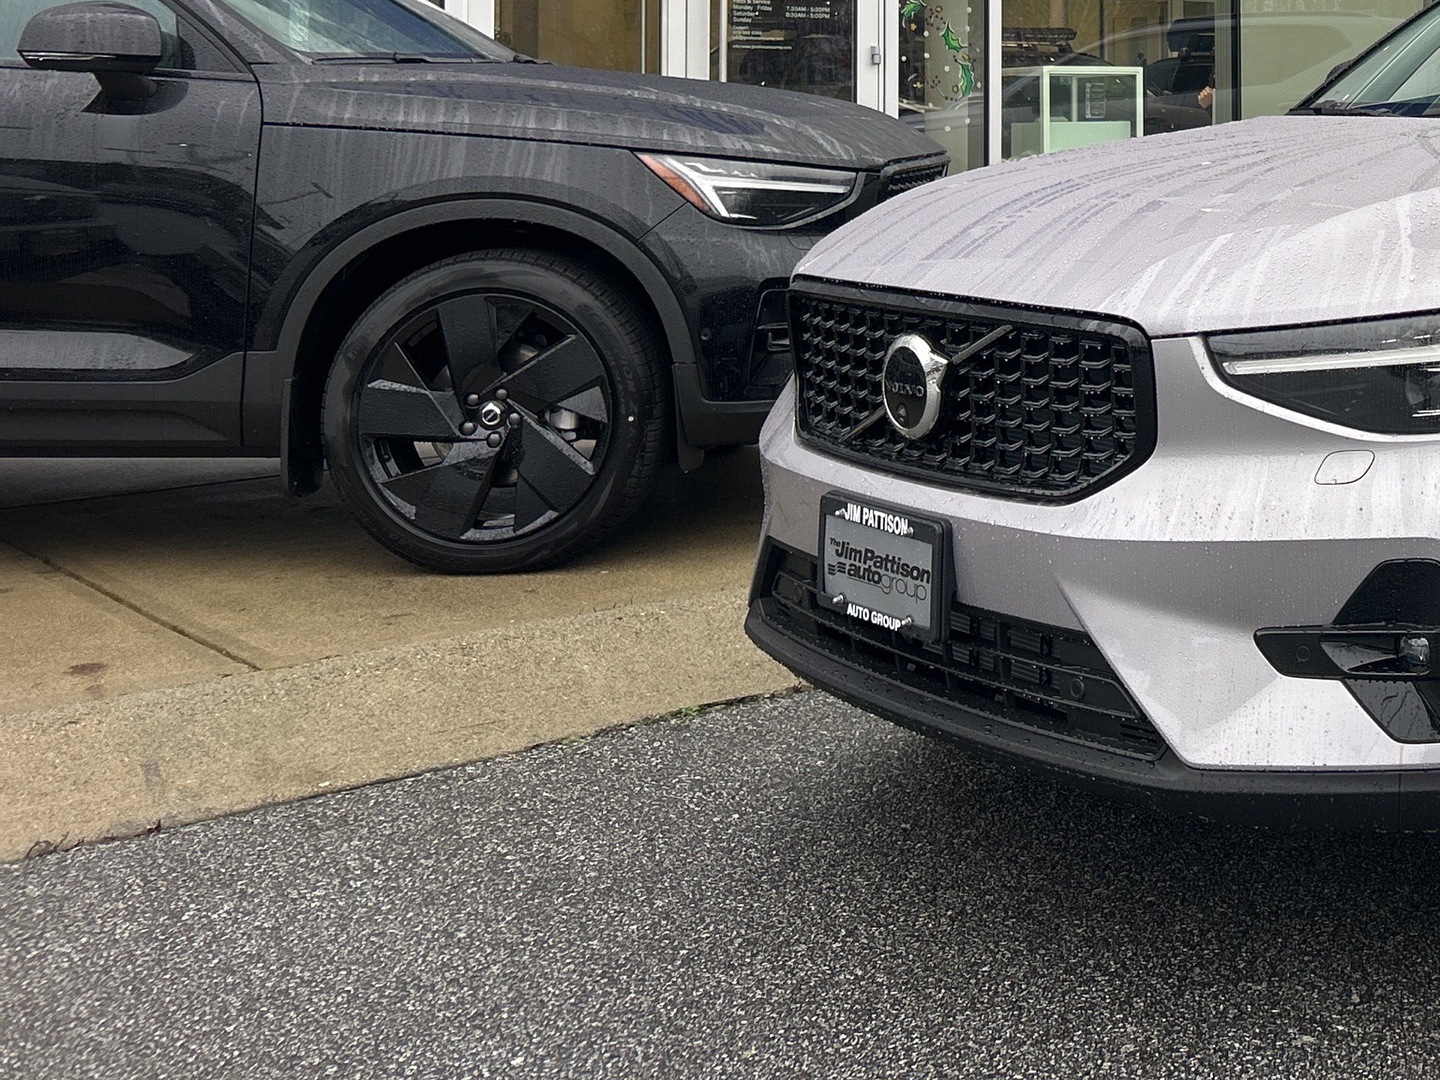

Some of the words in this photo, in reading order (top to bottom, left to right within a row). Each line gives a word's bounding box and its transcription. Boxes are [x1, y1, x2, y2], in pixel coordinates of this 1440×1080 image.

[886, 380, 925, 398] VOLVO
[843, 502, 862, 524] JIM
[862, 508, 909, 536] PATTISON
[829, 537, 841, 548] The
[846, 603, 870, 621] AUTO
[870, 610, 902, 633] GROUP
